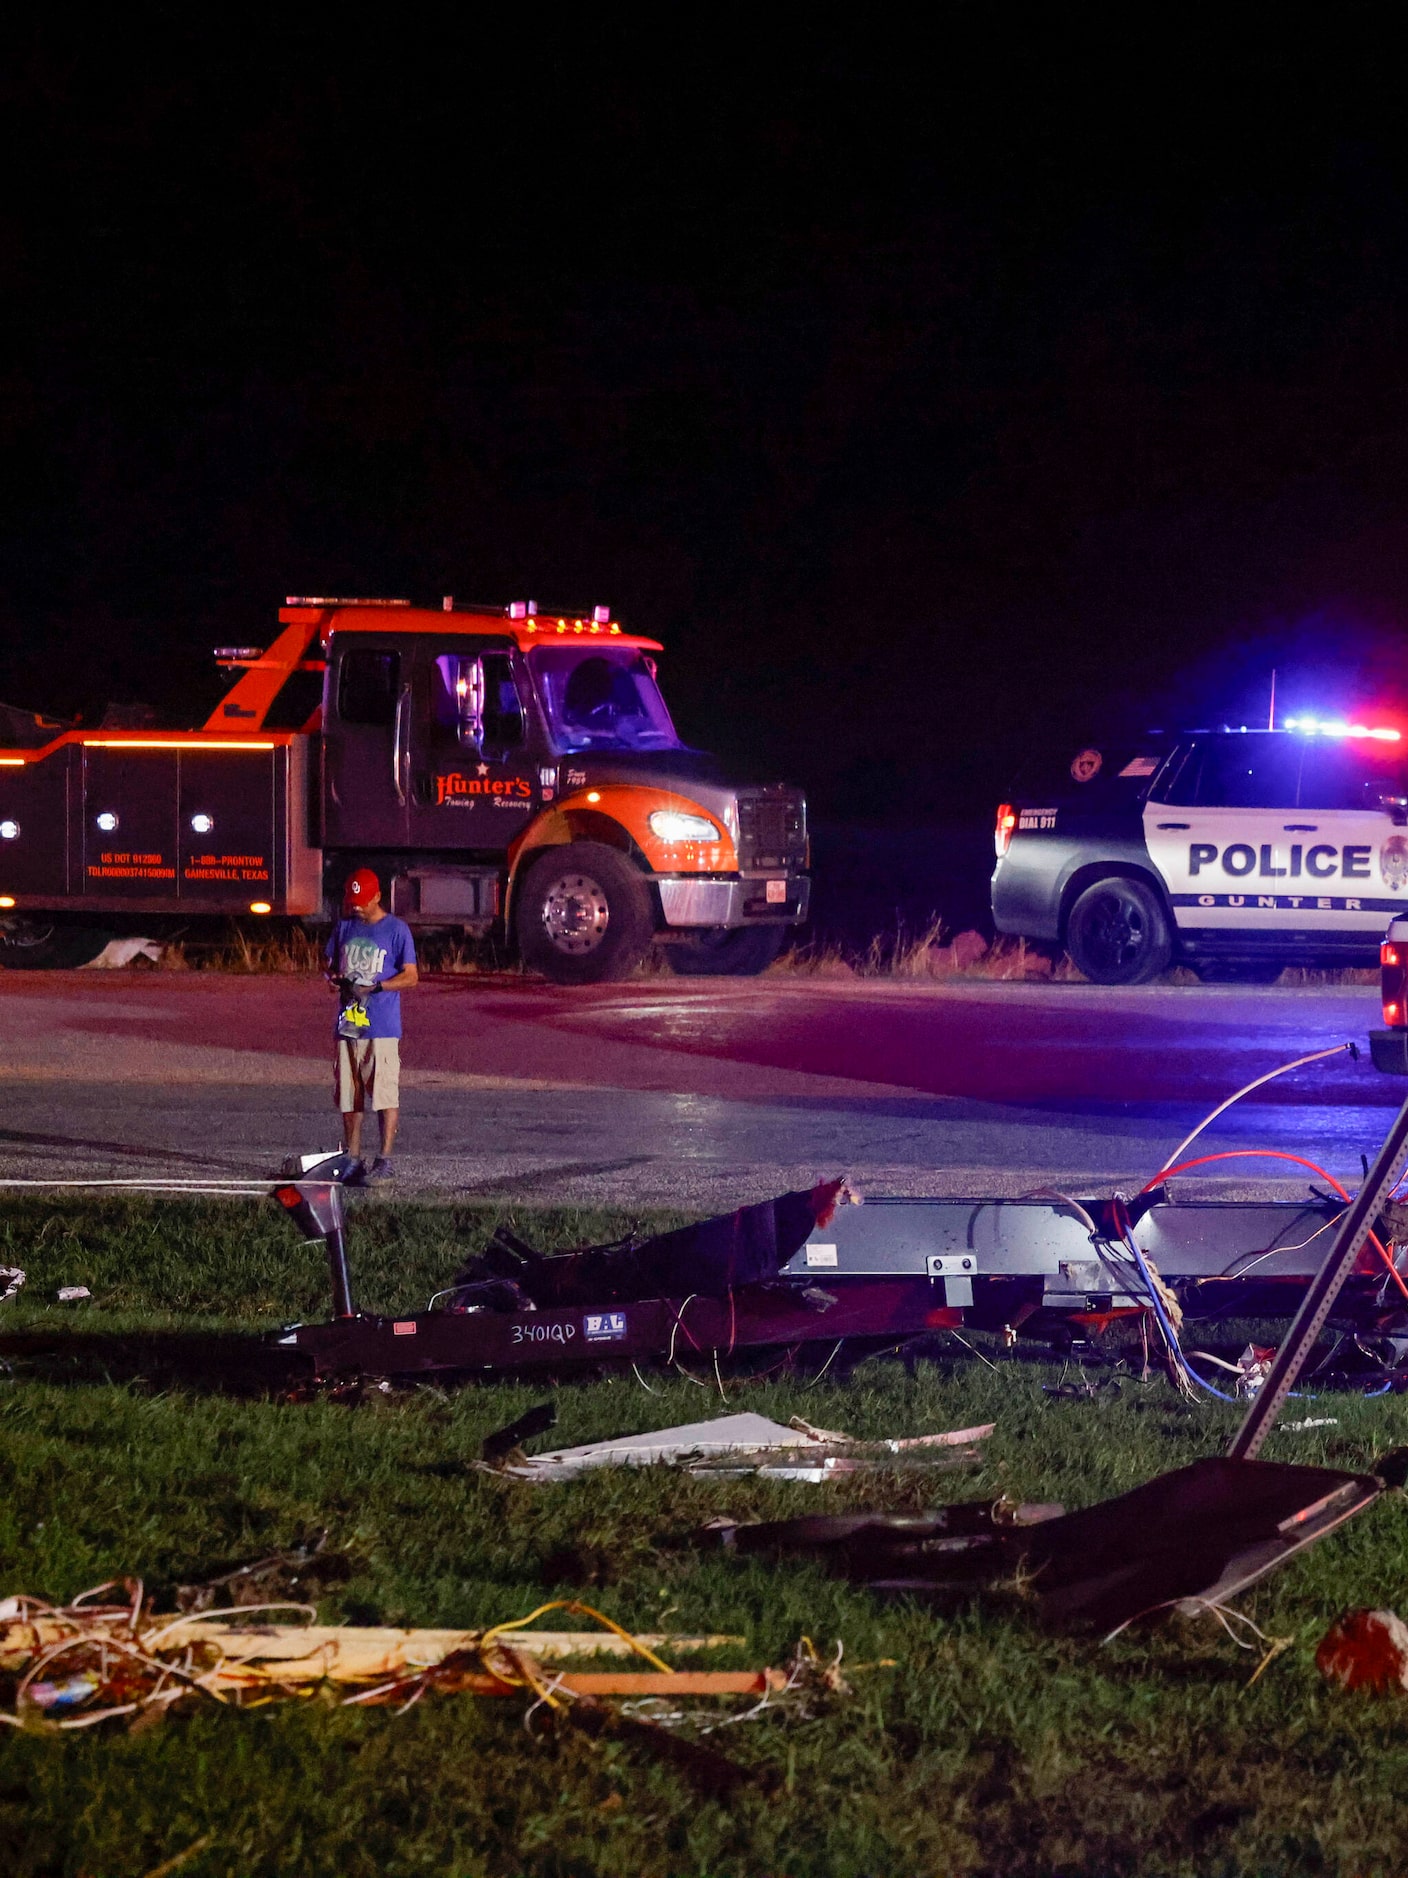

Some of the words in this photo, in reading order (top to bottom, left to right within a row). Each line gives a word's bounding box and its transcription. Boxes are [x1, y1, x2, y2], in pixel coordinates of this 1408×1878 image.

[436, 773, 532, 805] Hunter's
[444, 796, 475, 810] Towing
[493, 796, 532, 812] Recovery
[1020, 808, 1058, 816] EMERGENCY
[1019, 816, 1038, 830] DIAL
[1040, 816, 1056, 829] 911
[101, 853, 112, 863] US
[114, 853, 131, 864] DOT
[1188, 843, 1372, 878] POLICE
[242, 869, 269, 881] TEXAS
[1198, 895, 1362, 910] GUNTER
